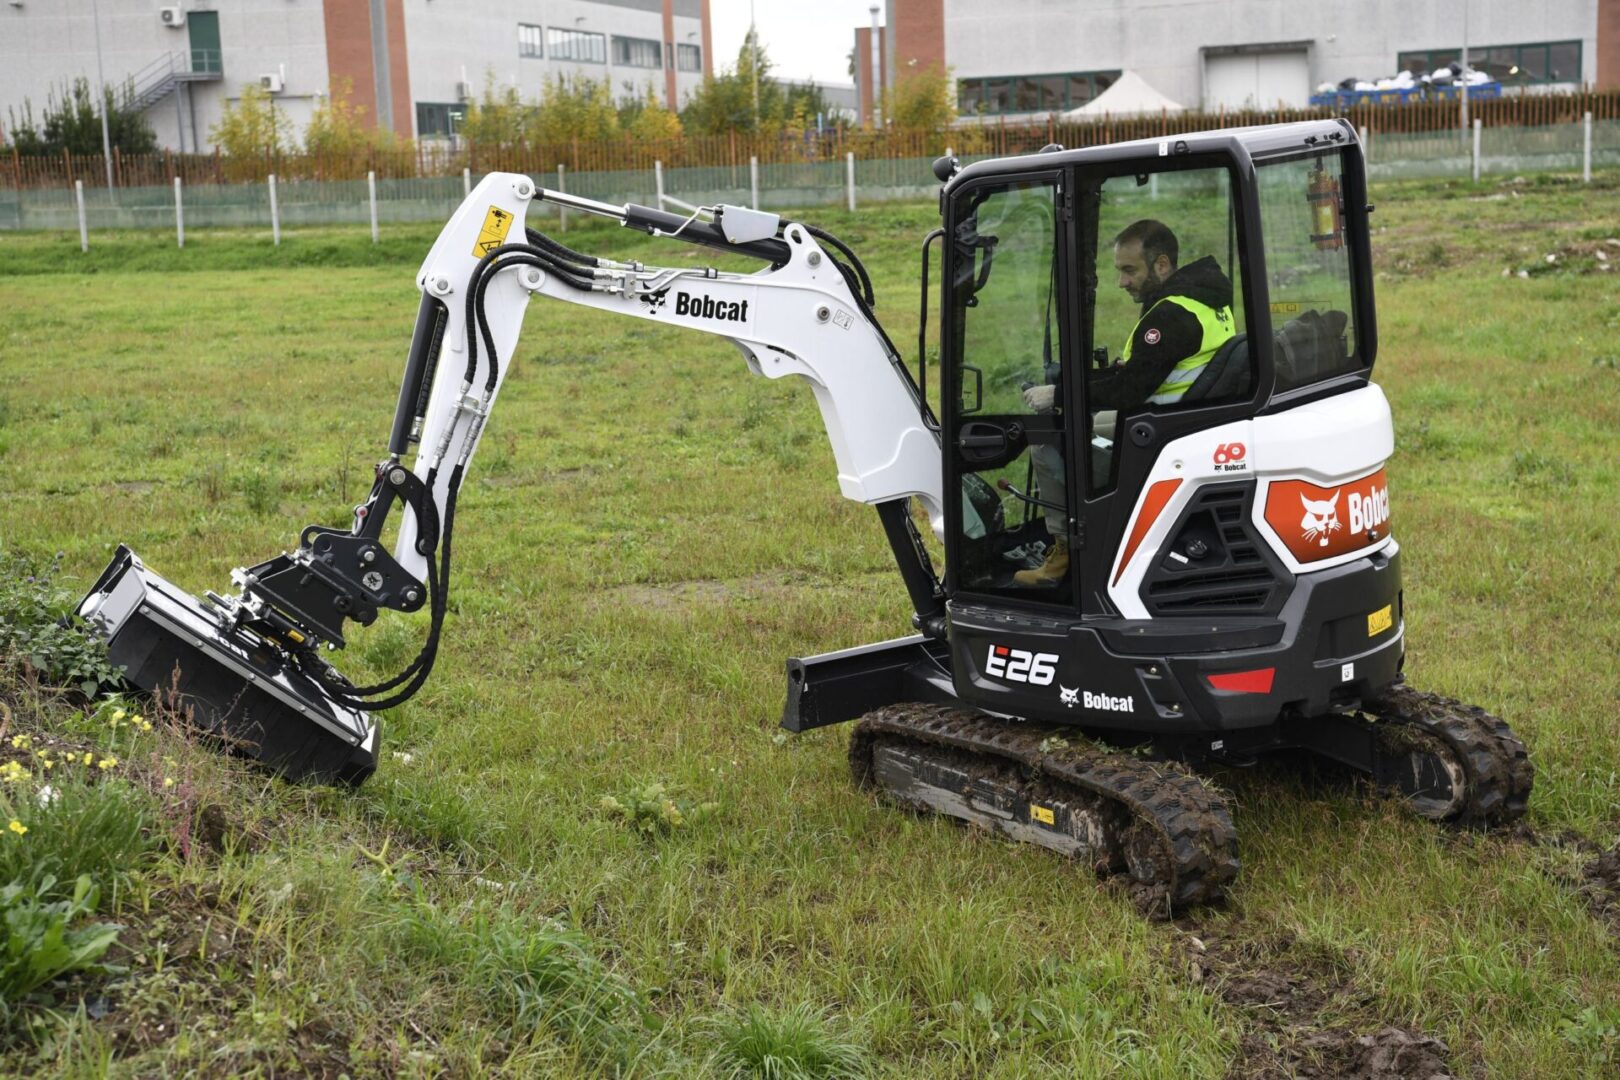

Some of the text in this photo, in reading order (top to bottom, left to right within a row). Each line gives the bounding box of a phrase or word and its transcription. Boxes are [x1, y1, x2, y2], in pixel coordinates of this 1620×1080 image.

[675, 291, 749, 323] Bobcat
[1213, 442, 1246, 465] 60
[1224, 463, 1247, 472] Bobcat
[985, 644, 1060, 686] E26
[1083, 690, 1135, 713] Bobcat
